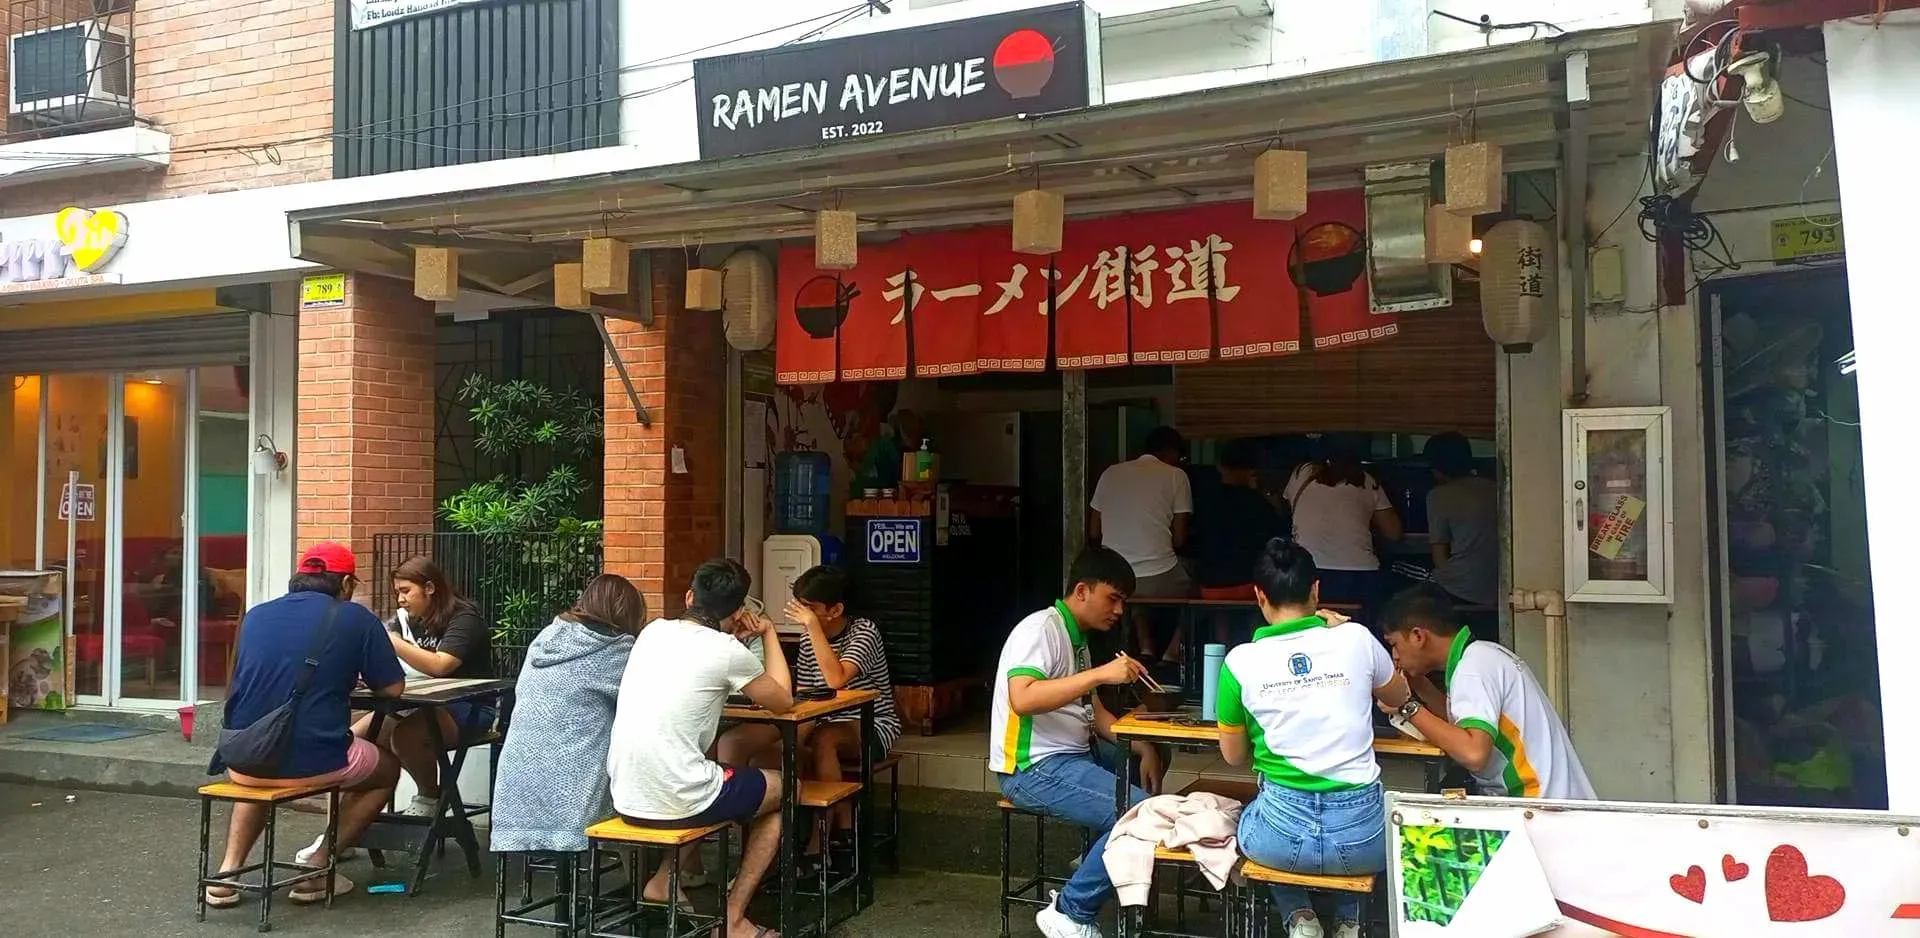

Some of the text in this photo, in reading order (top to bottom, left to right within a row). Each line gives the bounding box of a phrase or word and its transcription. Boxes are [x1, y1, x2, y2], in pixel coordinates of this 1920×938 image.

[712, 57, 986, 131] RAMEN AVENUE
[822, 120, 884, 140] EST. 2022
[1799, 227, 1836, 247] 793
[882, 233, 1241, 326] ラーメン街道
[1517, 245, 1545, 298] 街道
[317, 283, 333, 294] 789
[62, 500, 93, 516] OEN
[1590, 494, 1628, 551] BREAK GLASS
[1615, 517, 1634, 543] FIRE
[871, 530, 917, 553] OPEN
